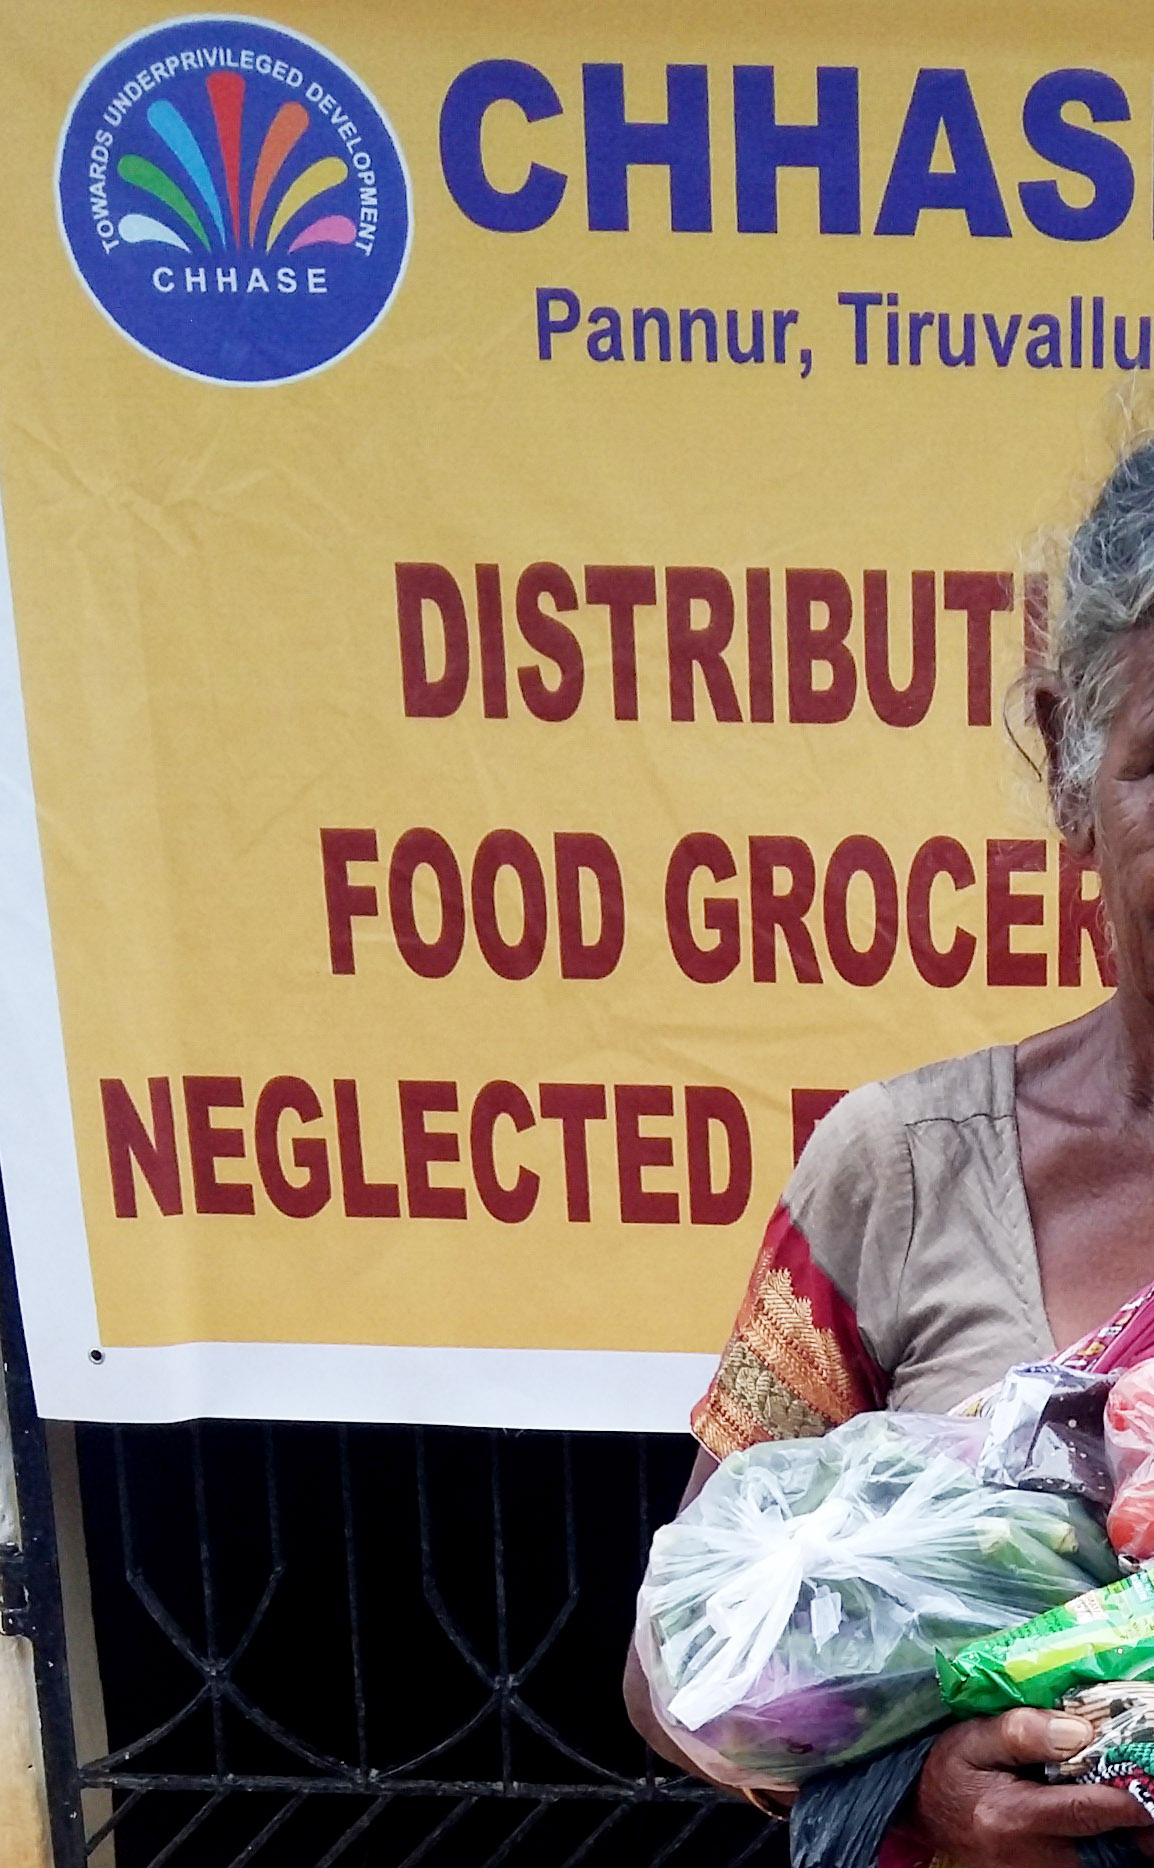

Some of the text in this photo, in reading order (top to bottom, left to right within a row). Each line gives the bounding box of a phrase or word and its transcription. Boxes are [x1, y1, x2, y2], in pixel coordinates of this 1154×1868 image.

[89, 46, 379, 257] TOWARDS UNDERPRIVILEGED DEVELOPMENT
[152, 266, 328, 294] CHHASE
[536, 287, 814, 379] Pannur,
[320, 827, 625, 981] FOOD
[665, 831, 1117, 989] GROCER
[100, 1074, 753, 1226] NEGLECTED
